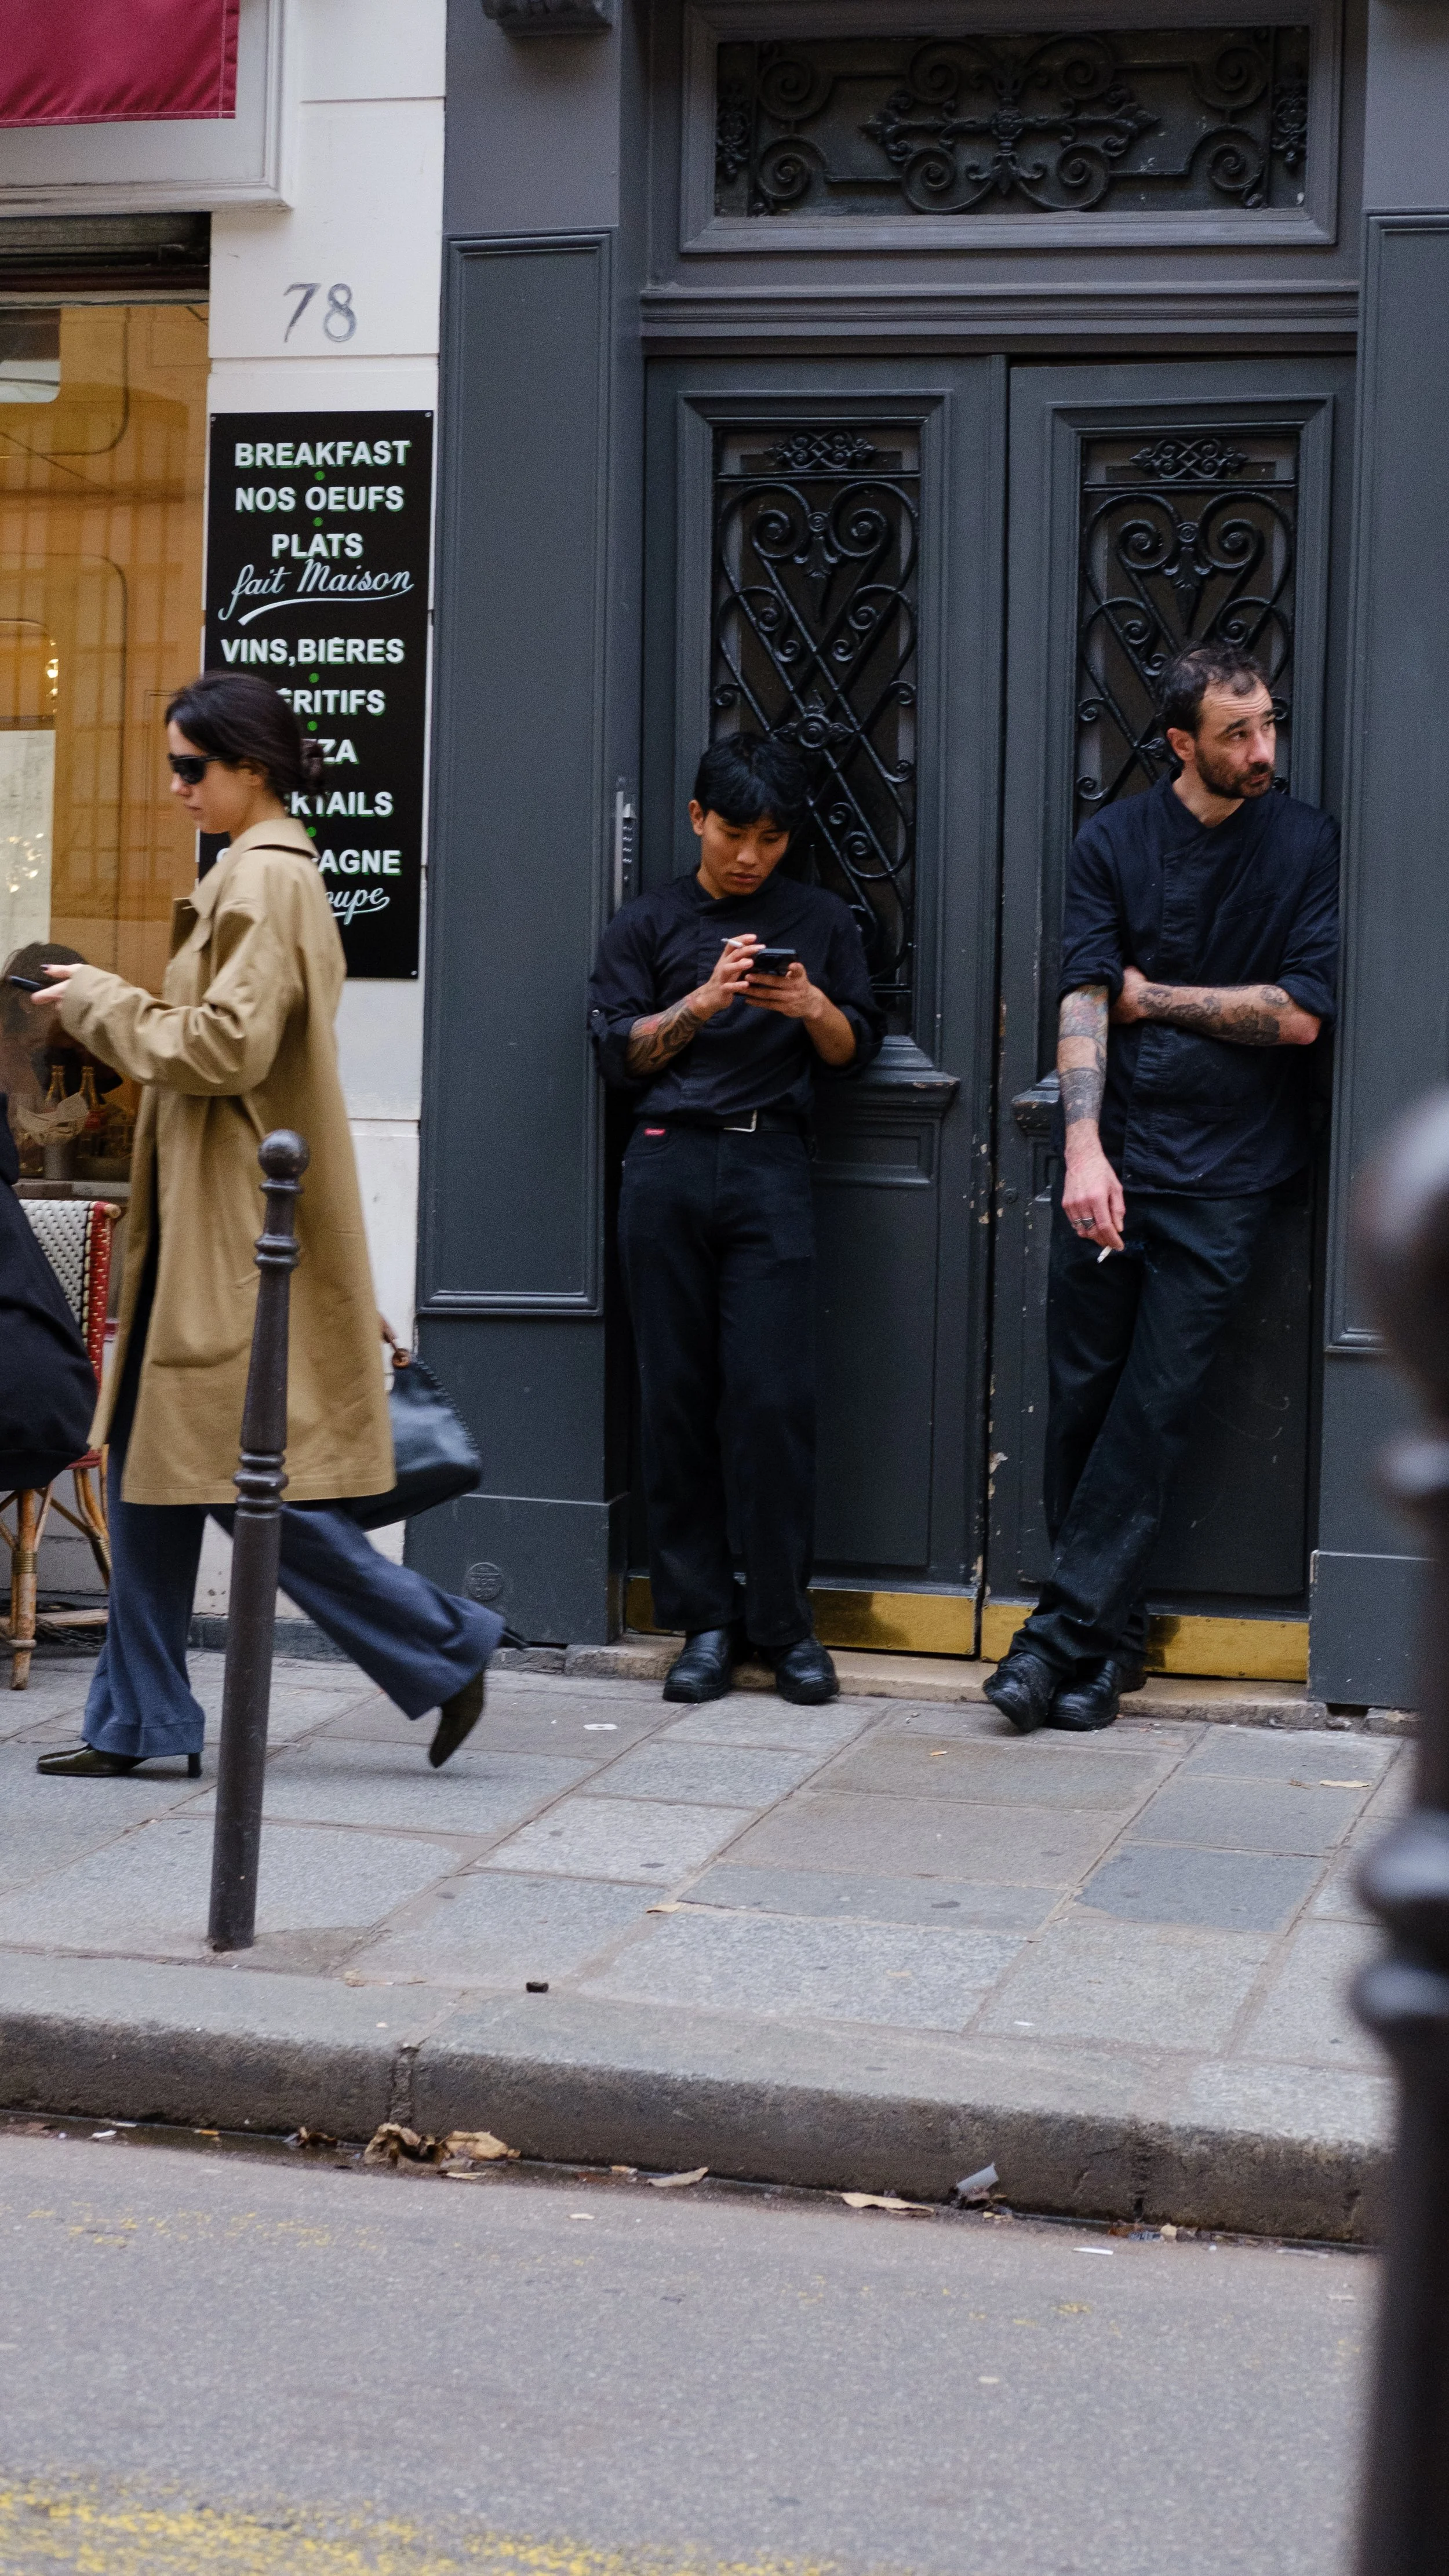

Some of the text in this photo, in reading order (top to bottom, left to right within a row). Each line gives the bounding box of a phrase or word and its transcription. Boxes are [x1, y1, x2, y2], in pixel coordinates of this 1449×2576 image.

[283, 282, 356, 343] 78
[235, 440, 412, 468] BREAKFAST
[235, 486, 405, 512] NOS OEUFS
[272, 533, 363, 559] PLATS
[218, 558, 414, 621] fait Maison
[276, 688, 386, 716] RITIFS
